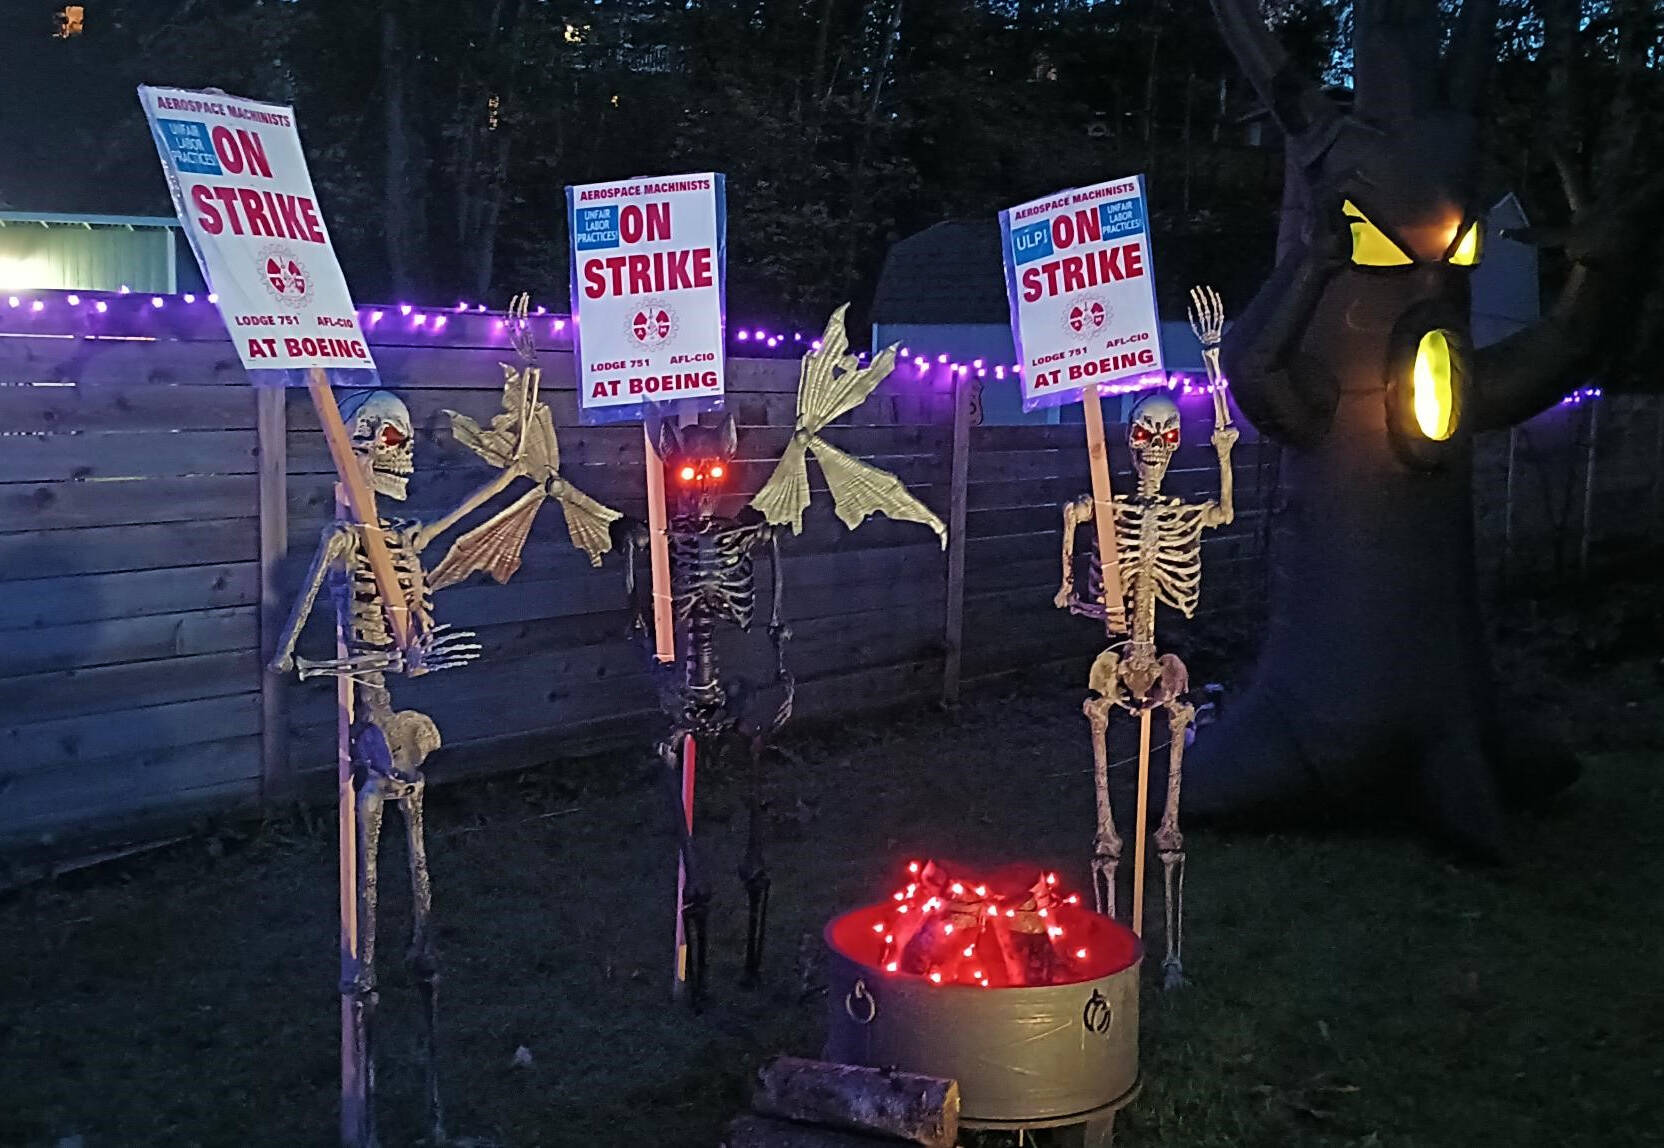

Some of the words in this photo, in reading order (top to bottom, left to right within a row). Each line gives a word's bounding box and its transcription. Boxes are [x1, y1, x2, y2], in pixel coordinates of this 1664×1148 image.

[157, 96, 226, 116] AEROSPACE
[227, 105, 291, 127] MACHINISTS
[211, 125, 273, 178] ON
[580, 185, 641, 201] AEROSPACE
[644, 180, 710, 195] MACHINISTS
[1015, 197, 1070, 220] AEROSPACE
[1072, 182, 1135, 204] MACHINISTS
[191, 184, 326, 244] STRIKE
[584, 208, 611, 220] UNFAIR
[1106, 201, 1133, 214] UNFAIR
[1109, 211, 1133, 223] LABOR
[585, 219, 610, 231] LABOR
[619, 202, 671, 244] ON
[1052, 207, 1101, 249] ON
[584, 248, 713, 299] STRIKE
[1022, 243, 1144, 303] STRIKE
[235, 315, 276, 326] LODGE
[277, 315, 300, 325] 751
[317, 316, 354, 328] AFL-CIO
[247, 338, 278, 358] AT
[284, 337, 367, 358] BOEING
[1106, 332, 1149, 349] AFL-CIO
[591, 360, 626, 372] LODGE
[630, 358, 650, 368] 751
[670, 353, 715, 364] AFL-CIO
[1032, 352, 1065, 366] LODGE
[1069, 347, 1088, 358] 751
[1034, 369, 1062, 388] AT
[1069, 349, 1154, 380] BOEING
[592, 380, 621, 398] AT
[629, 371, 718, 394] BOEING
